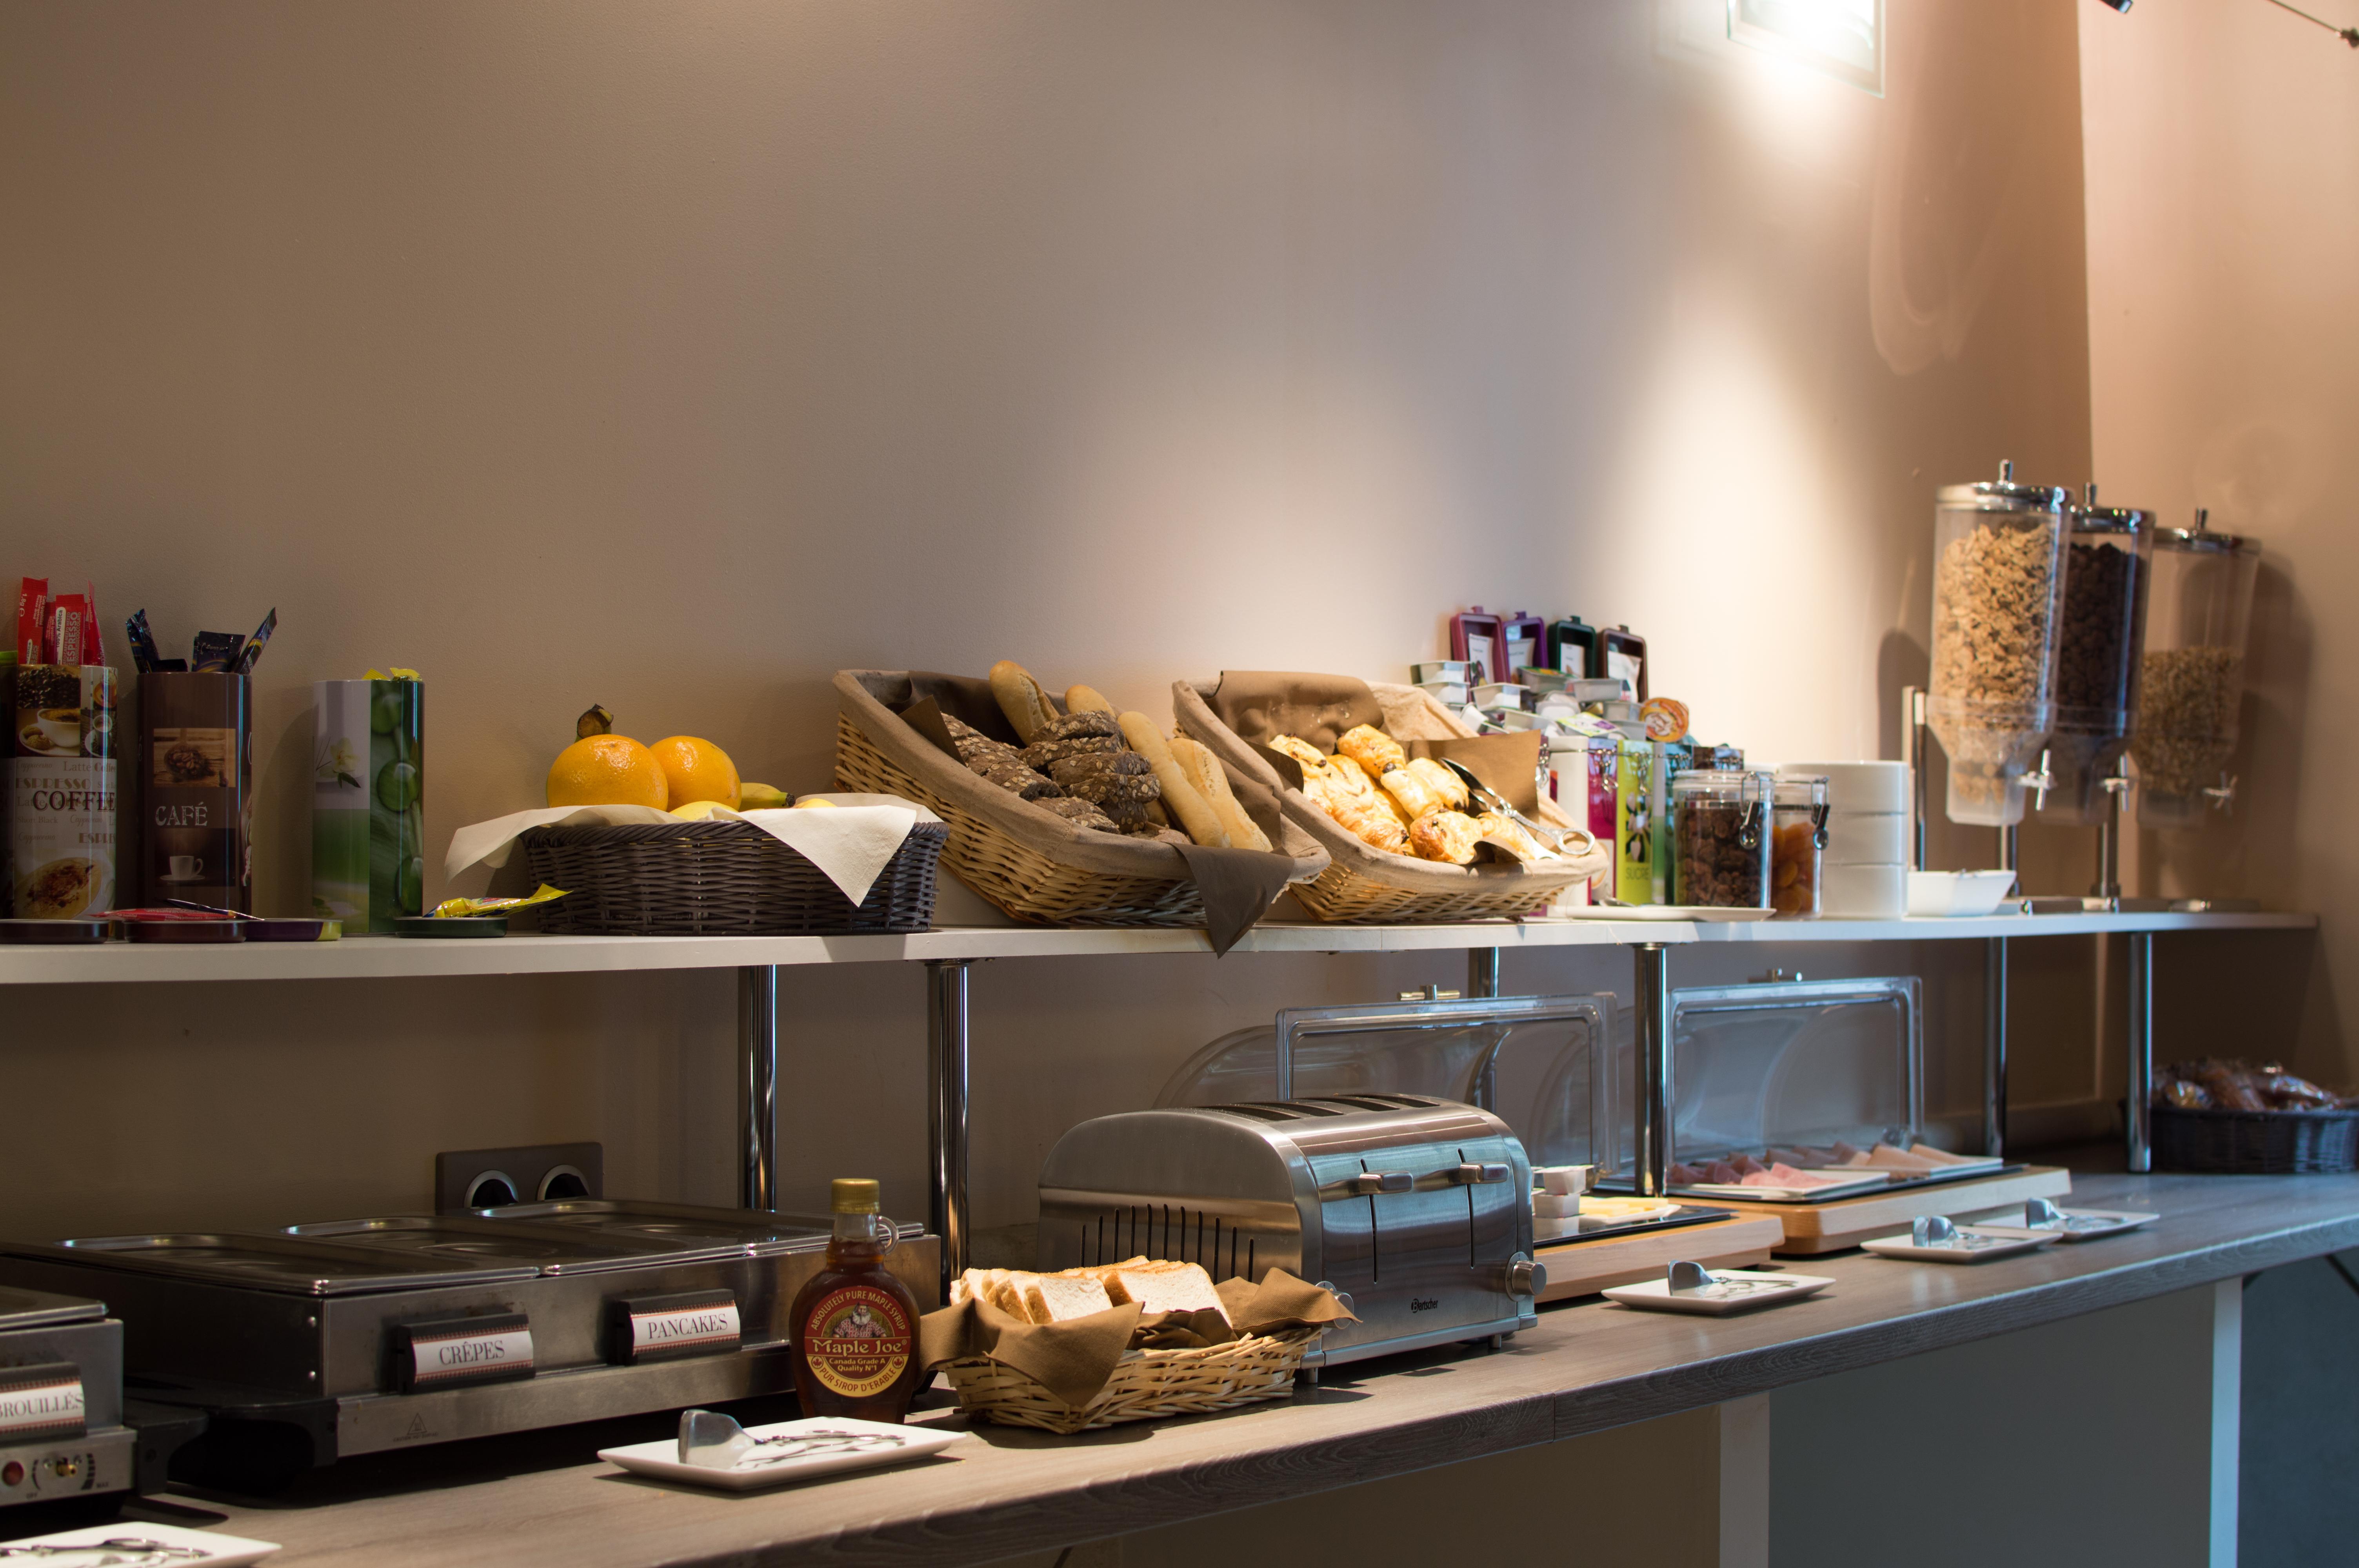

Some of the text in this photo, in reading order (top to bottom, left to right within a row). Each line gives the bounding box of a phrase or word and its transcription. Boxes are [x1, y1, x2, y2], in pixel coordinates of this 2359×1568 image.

[67, 612, 78, 662] ESPRESSO
[63, 761, 91, 772] Latte
[16, 778, 91, 789] ESPRESSO
[33, 790, 115, 812] COFFEE
[155, 802, 208, 827] CAFÉ
[811, 1290, 906, 1330] ABSOLUTELY PURE MAPLE SYRUP
[1411, 1298, 1438, 1314] Bartscher
[648, 1313, 728, 1339] PANCAKES
[440, 1340, 505, 1365] CRÊPES
[812, 1339, 869, 1357] Maple
[819, 1367, 897, 1392] PUR SIROP D'ERABLE
